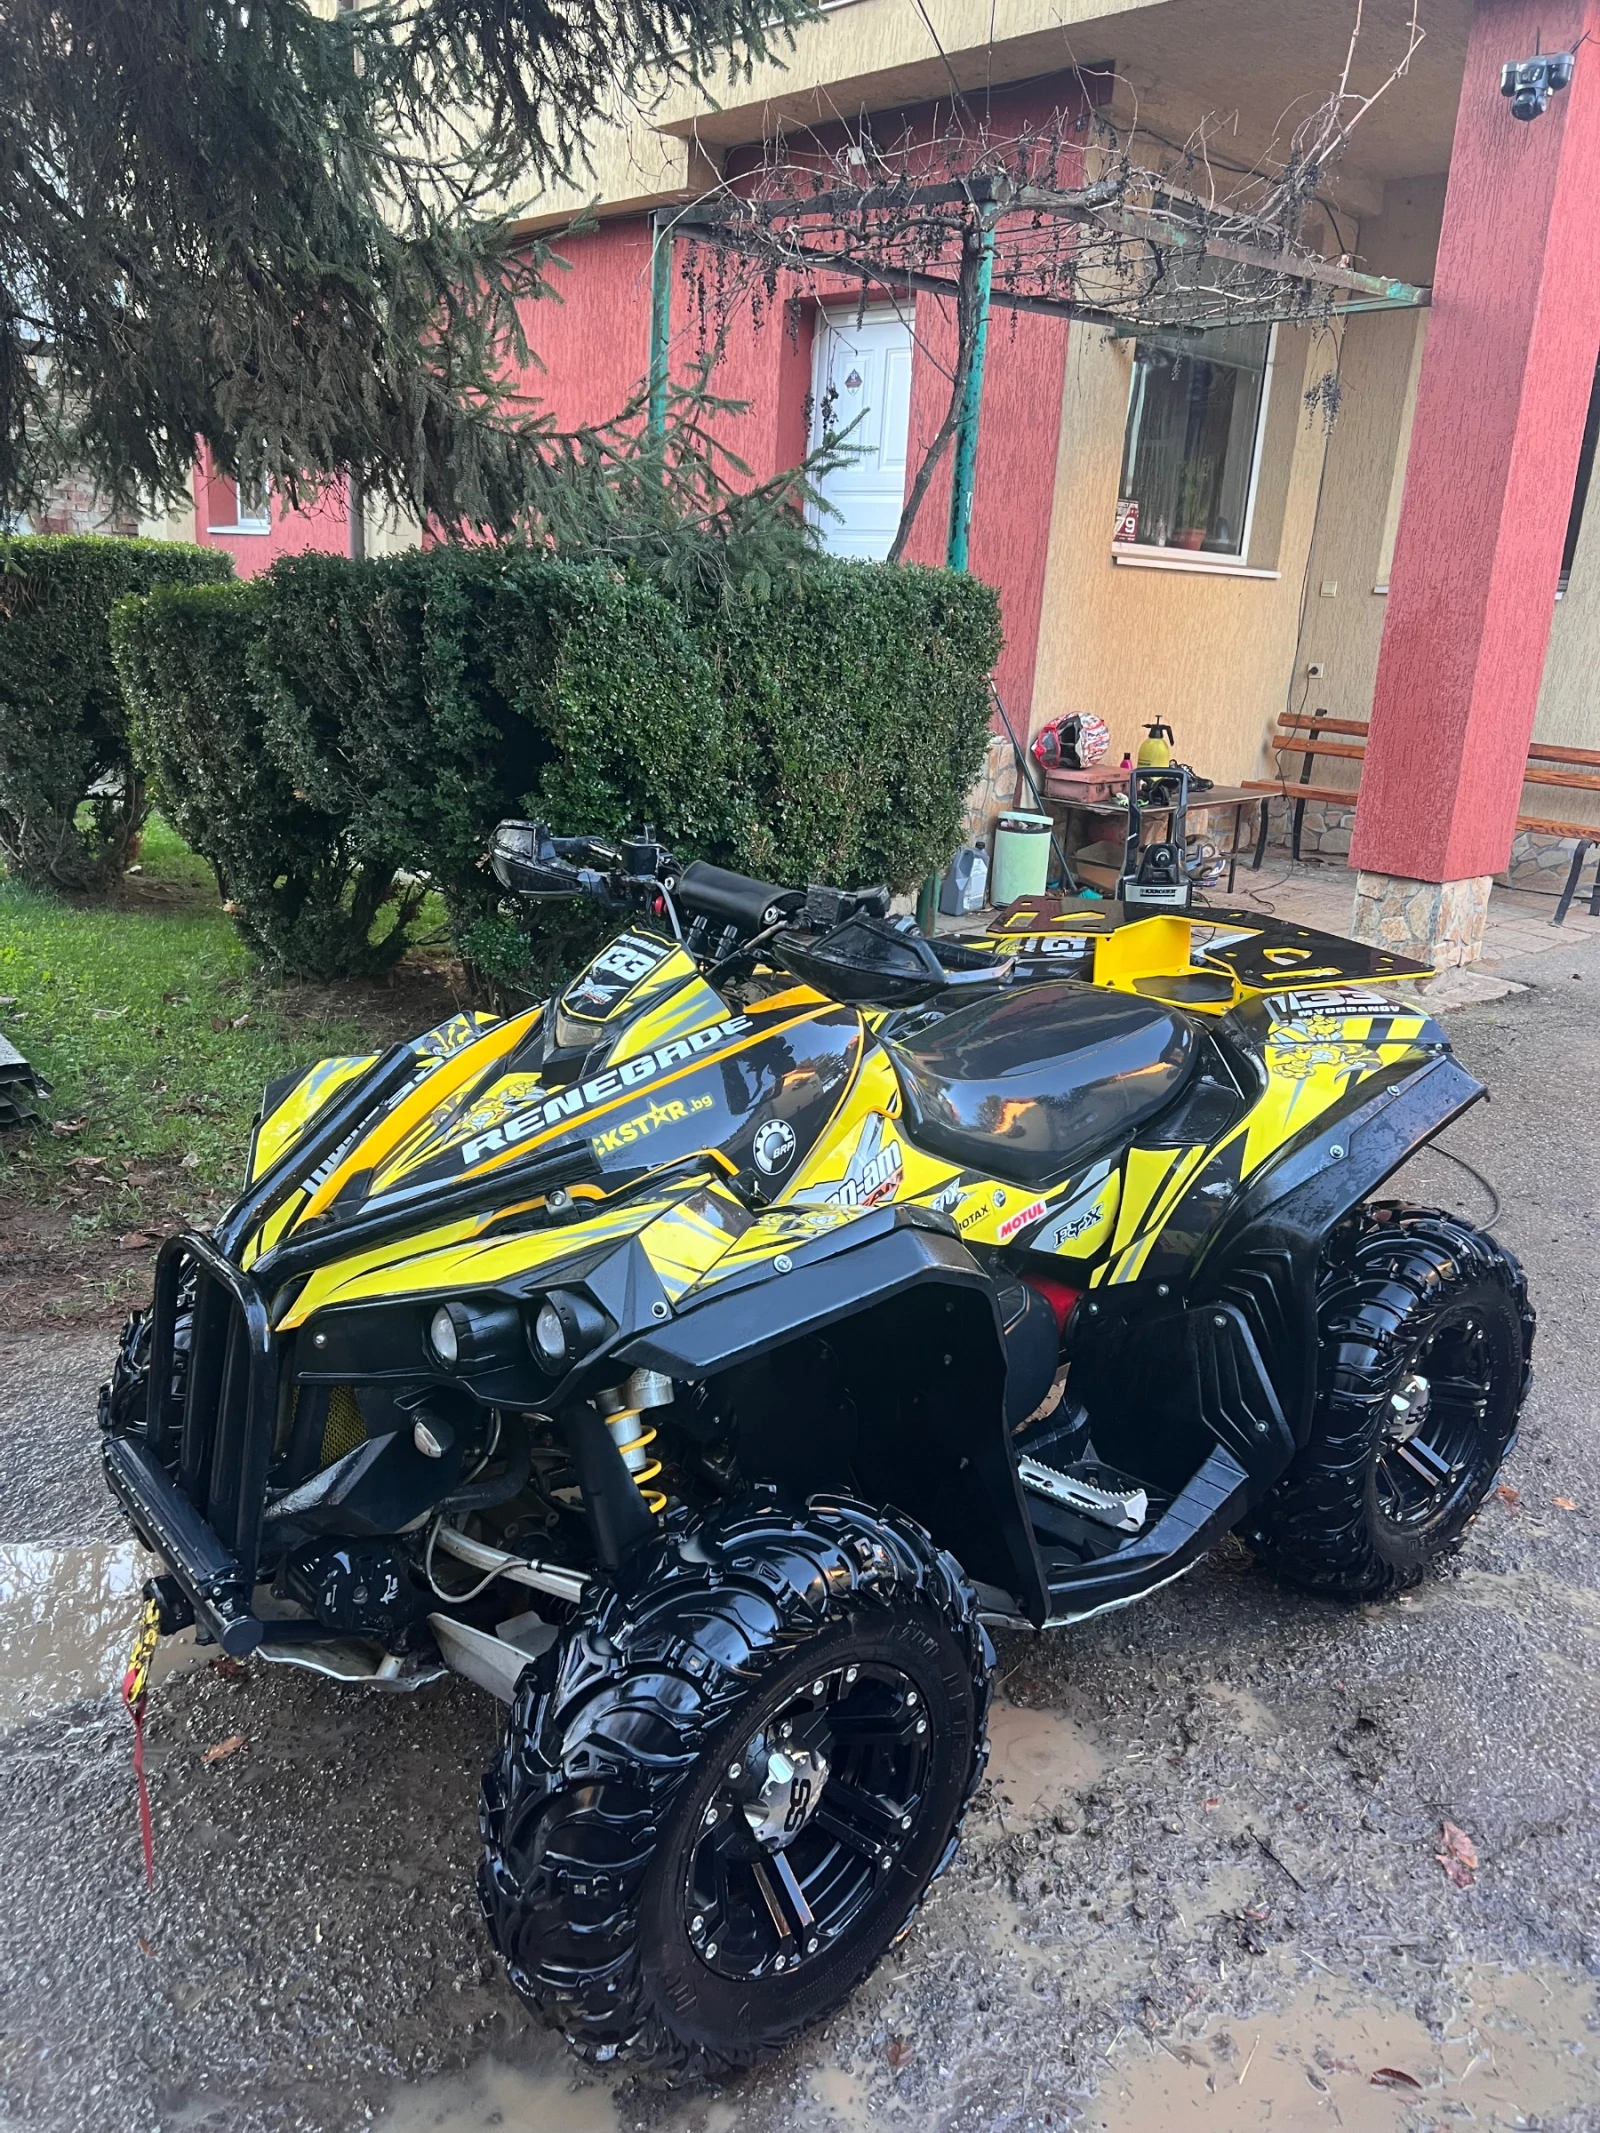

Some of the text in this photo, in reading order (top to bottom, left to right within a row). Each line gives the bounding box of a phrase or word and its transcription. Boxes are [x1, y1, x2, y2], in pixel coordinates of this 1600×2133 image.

[1297, 1005, 1400, 1018] M.YORDANOV
[461, 1015, 753, 1165] RENEGADE
[773, 1140, 794, 1160] BRP
[1000, 1201, 1045, 1239] MOTUL
